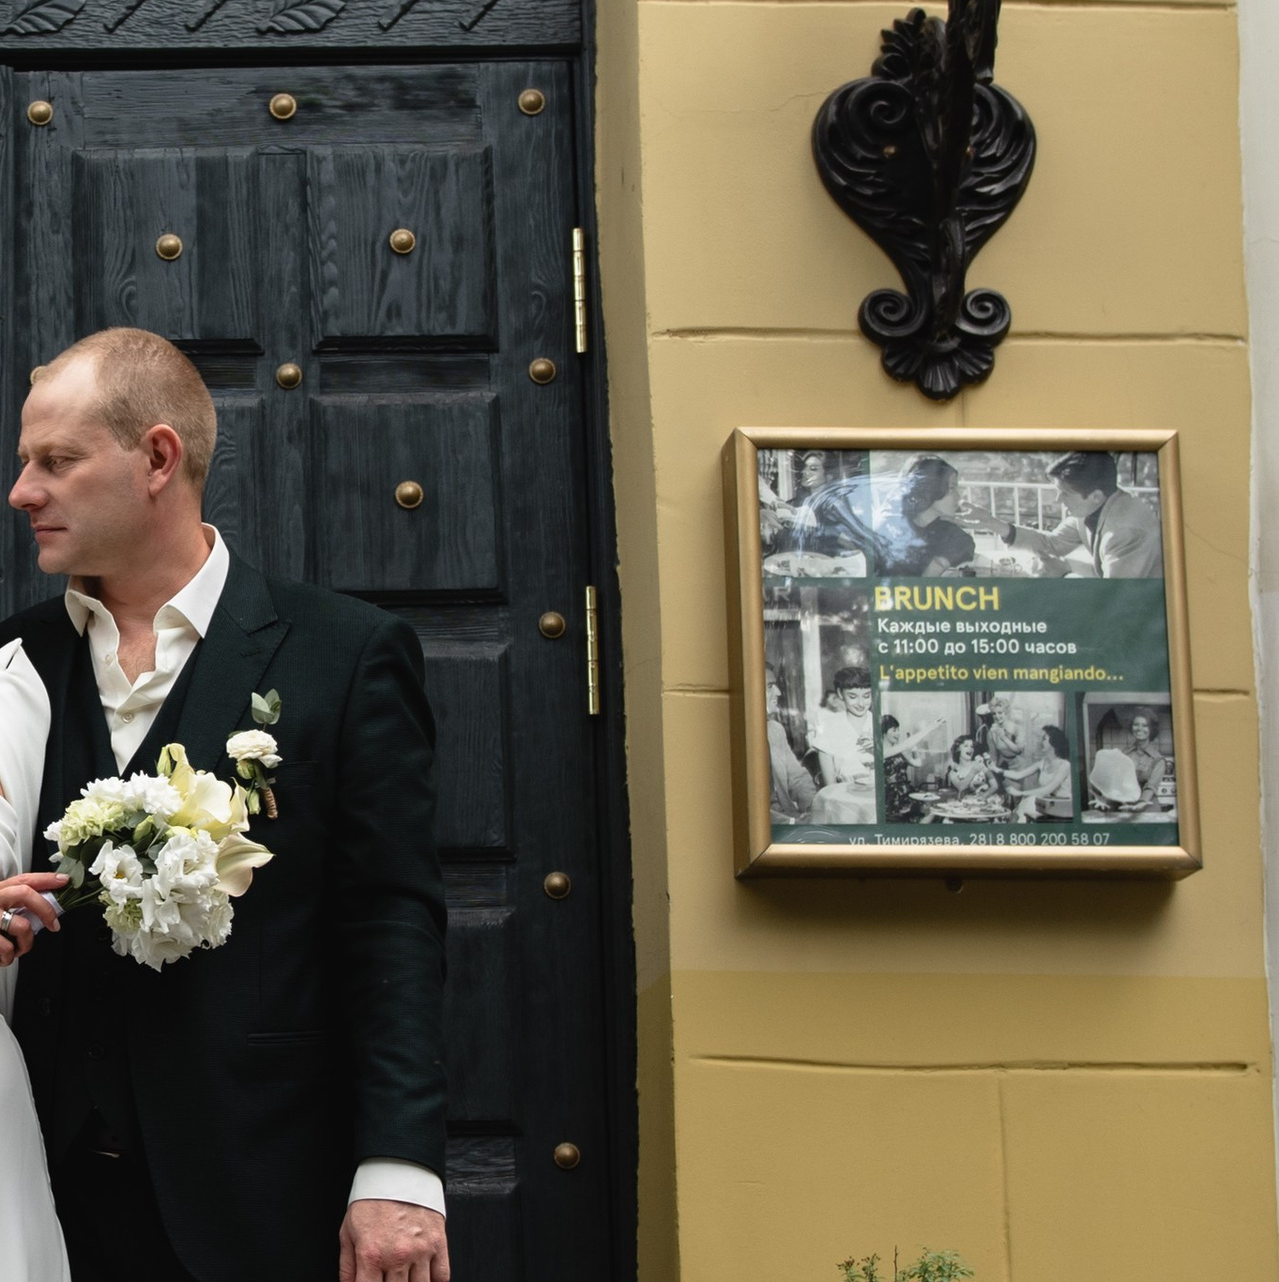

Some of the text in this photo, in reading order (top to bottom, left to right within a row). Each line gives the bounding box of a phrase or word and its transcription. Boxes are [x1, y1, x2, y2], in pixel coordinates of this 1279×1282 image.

[874, 586, 1000, 611] BRUNCH
[878, 618, 1048, 635] Каждые выходные
[878, 639, 1077, 656] с 11:00 до 15:00 часов
[879, 664, 1124, 684] L'appetito vien mangiando...
[969, 833, 987, 846] 28
[1009, 833, 1036, 846] 800
[1040, 833, 1067, 846] 200
[1071, 833, 1089, 846] 58
[1093, 833, 1110, 846] 07
